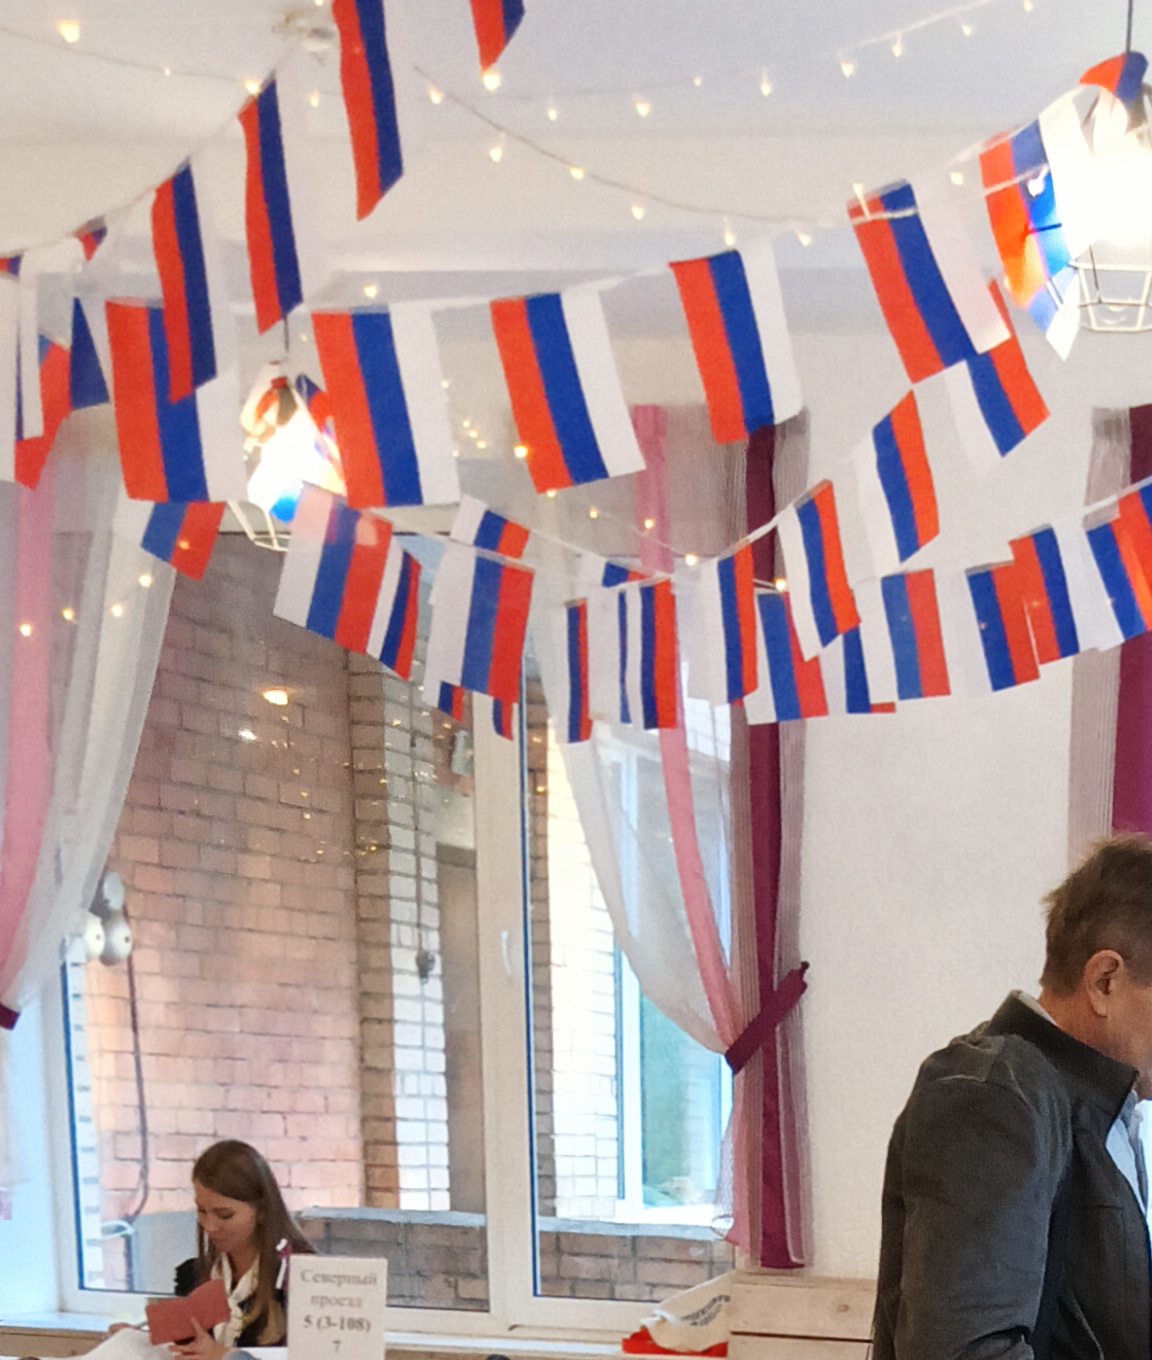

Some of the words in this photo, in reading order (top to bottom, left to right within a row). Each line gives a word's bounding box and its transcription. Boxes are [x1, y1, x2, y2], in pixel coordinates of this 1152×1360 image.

[299, 1268, 379, 1288] Северный
[309, 1293, 363, 1309] проезд
[303, 1315, 313, 1329] 5
[332, 1340, 342, 1354] 7
